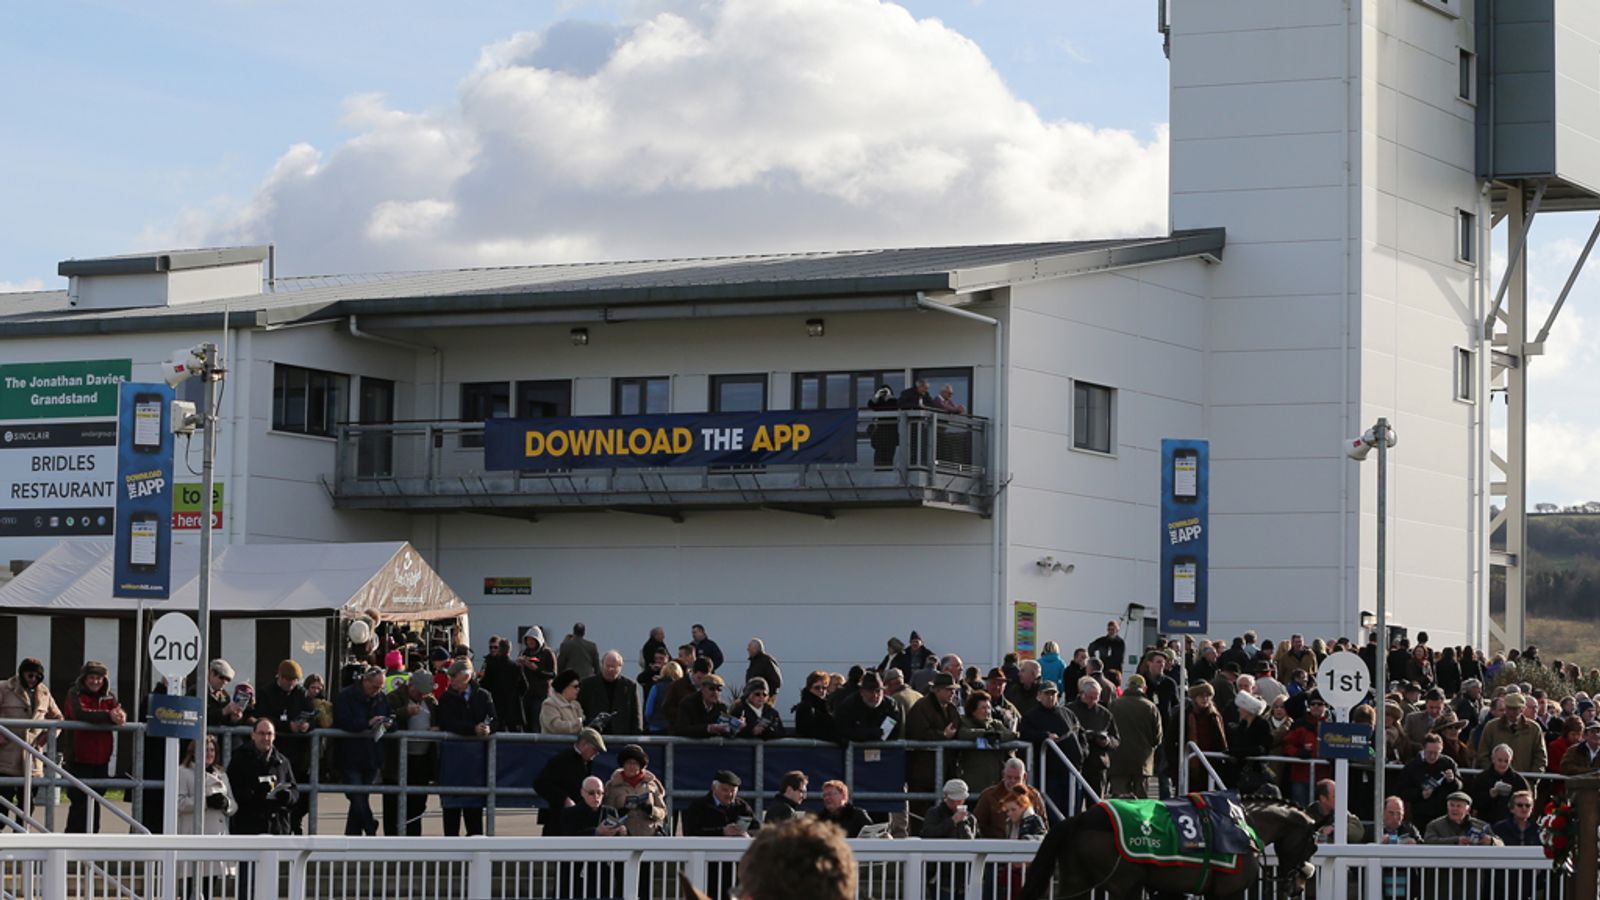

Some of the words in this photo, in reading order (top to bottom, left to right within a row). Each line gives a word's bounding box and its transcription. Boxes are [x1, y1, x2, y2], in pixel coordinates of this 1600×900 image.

[5, 377, 27, 389] The
[29, 375, 83, 388] Jonathan
[86, 373, 126, 386] Davies
[31, 391, 98, 405] Grandstand
[13, 431, 50, 440] SINCLAIR
[525, 427, 693, 457] DOWNLOAD
[701, 428, 744, 450] THE
[752, 424, 811, 452] APP
[31, 454, 96, 472] BRIDLES
[126, 470, 162, 483] DOWNLOAD
[11, 481, 115, 499] RESTAURANT
[137, 478, 166, 498] APP
[182, 486, 220, 505] toe
[1179, 525, 1202, 542] APP
[153, 634, 199, 661] 2nd
[1325, 669, 1363, 692] 1st
[1178, 815, 1198, 839] 3
